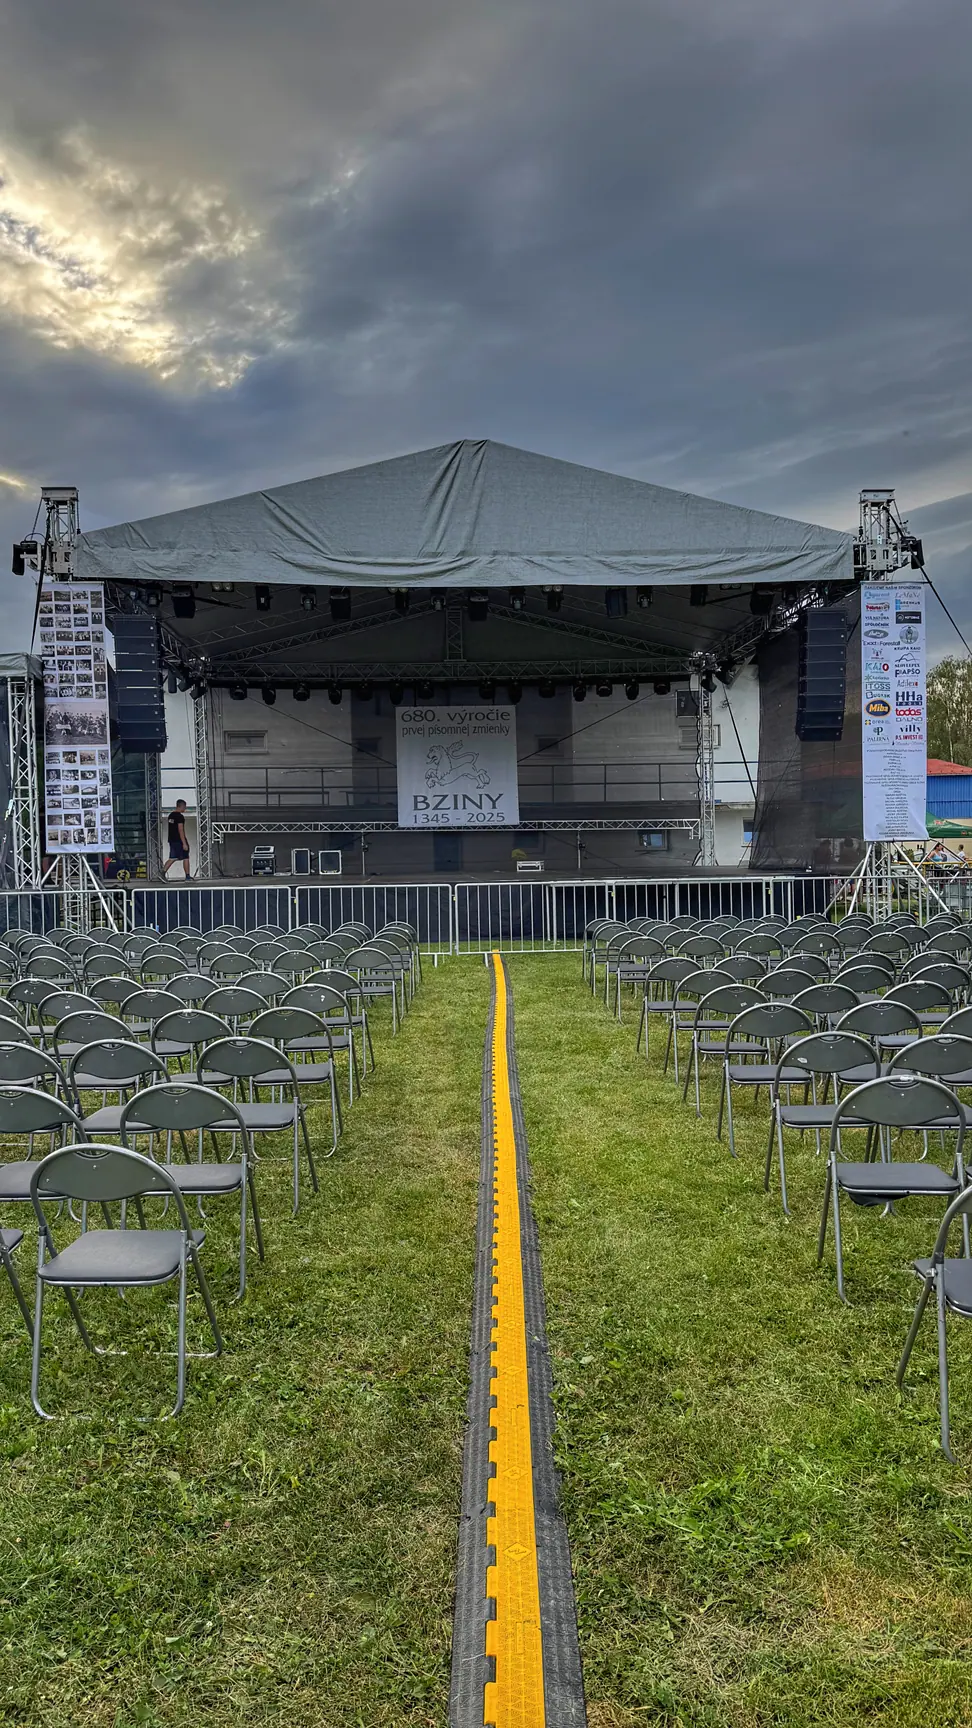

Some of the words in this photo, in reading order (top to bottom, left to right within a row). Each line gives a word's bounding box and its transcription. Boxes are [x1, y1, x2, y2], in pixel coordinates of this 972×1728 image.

[401, 709, 440, 723] 680.
[446, 709, 511, 725] výročie
[895, 707, 922, 717] todos
[402, 725, 425, 738] prvej
[472, 724, 510, 736] zmienky
[412, 794, 504, 811] BZINY
[413, 813, 450, 824] 1345
[467, 812, 506, 823] 2025
